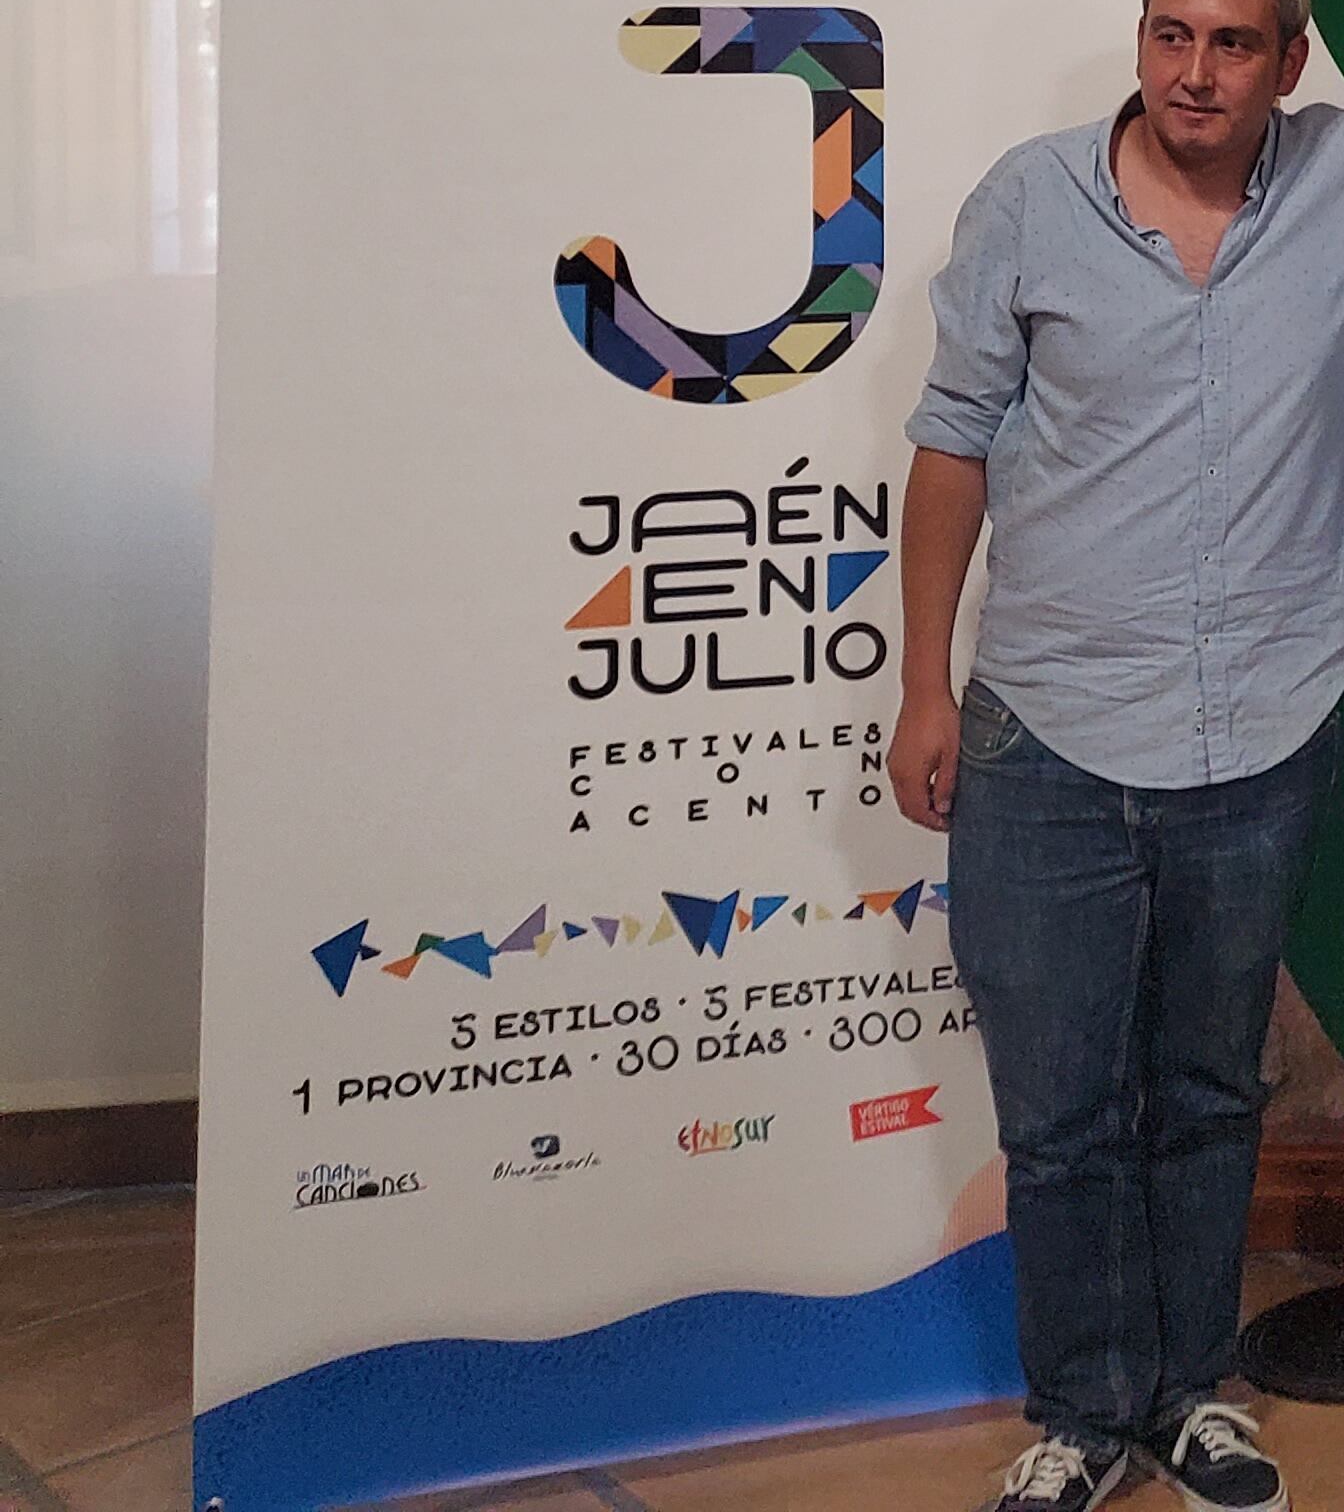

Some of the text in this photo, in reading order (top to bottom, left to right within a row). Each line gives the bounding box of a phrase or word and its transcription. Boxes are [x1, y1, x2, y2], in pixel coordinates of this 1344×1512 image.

[568, 456, 888, 556] JAÉN
[643, 556, 815, 624] EN
[568, 622, 887, 700] JULIO
[569, 722, 881, 769] FESTIVALES
[569, 784, 881, 832] ACENTO
[495, 996, 661, 1040] ESTILOS
[292, 1078, 310, 1115] 1
[338, 1053, 572, 1106] PROVINCIA
[616, 1035, 679, 1076] 30
[696, 1020, 787, 1063] DÍAS
[829, 1007, 922, 1052] 300
